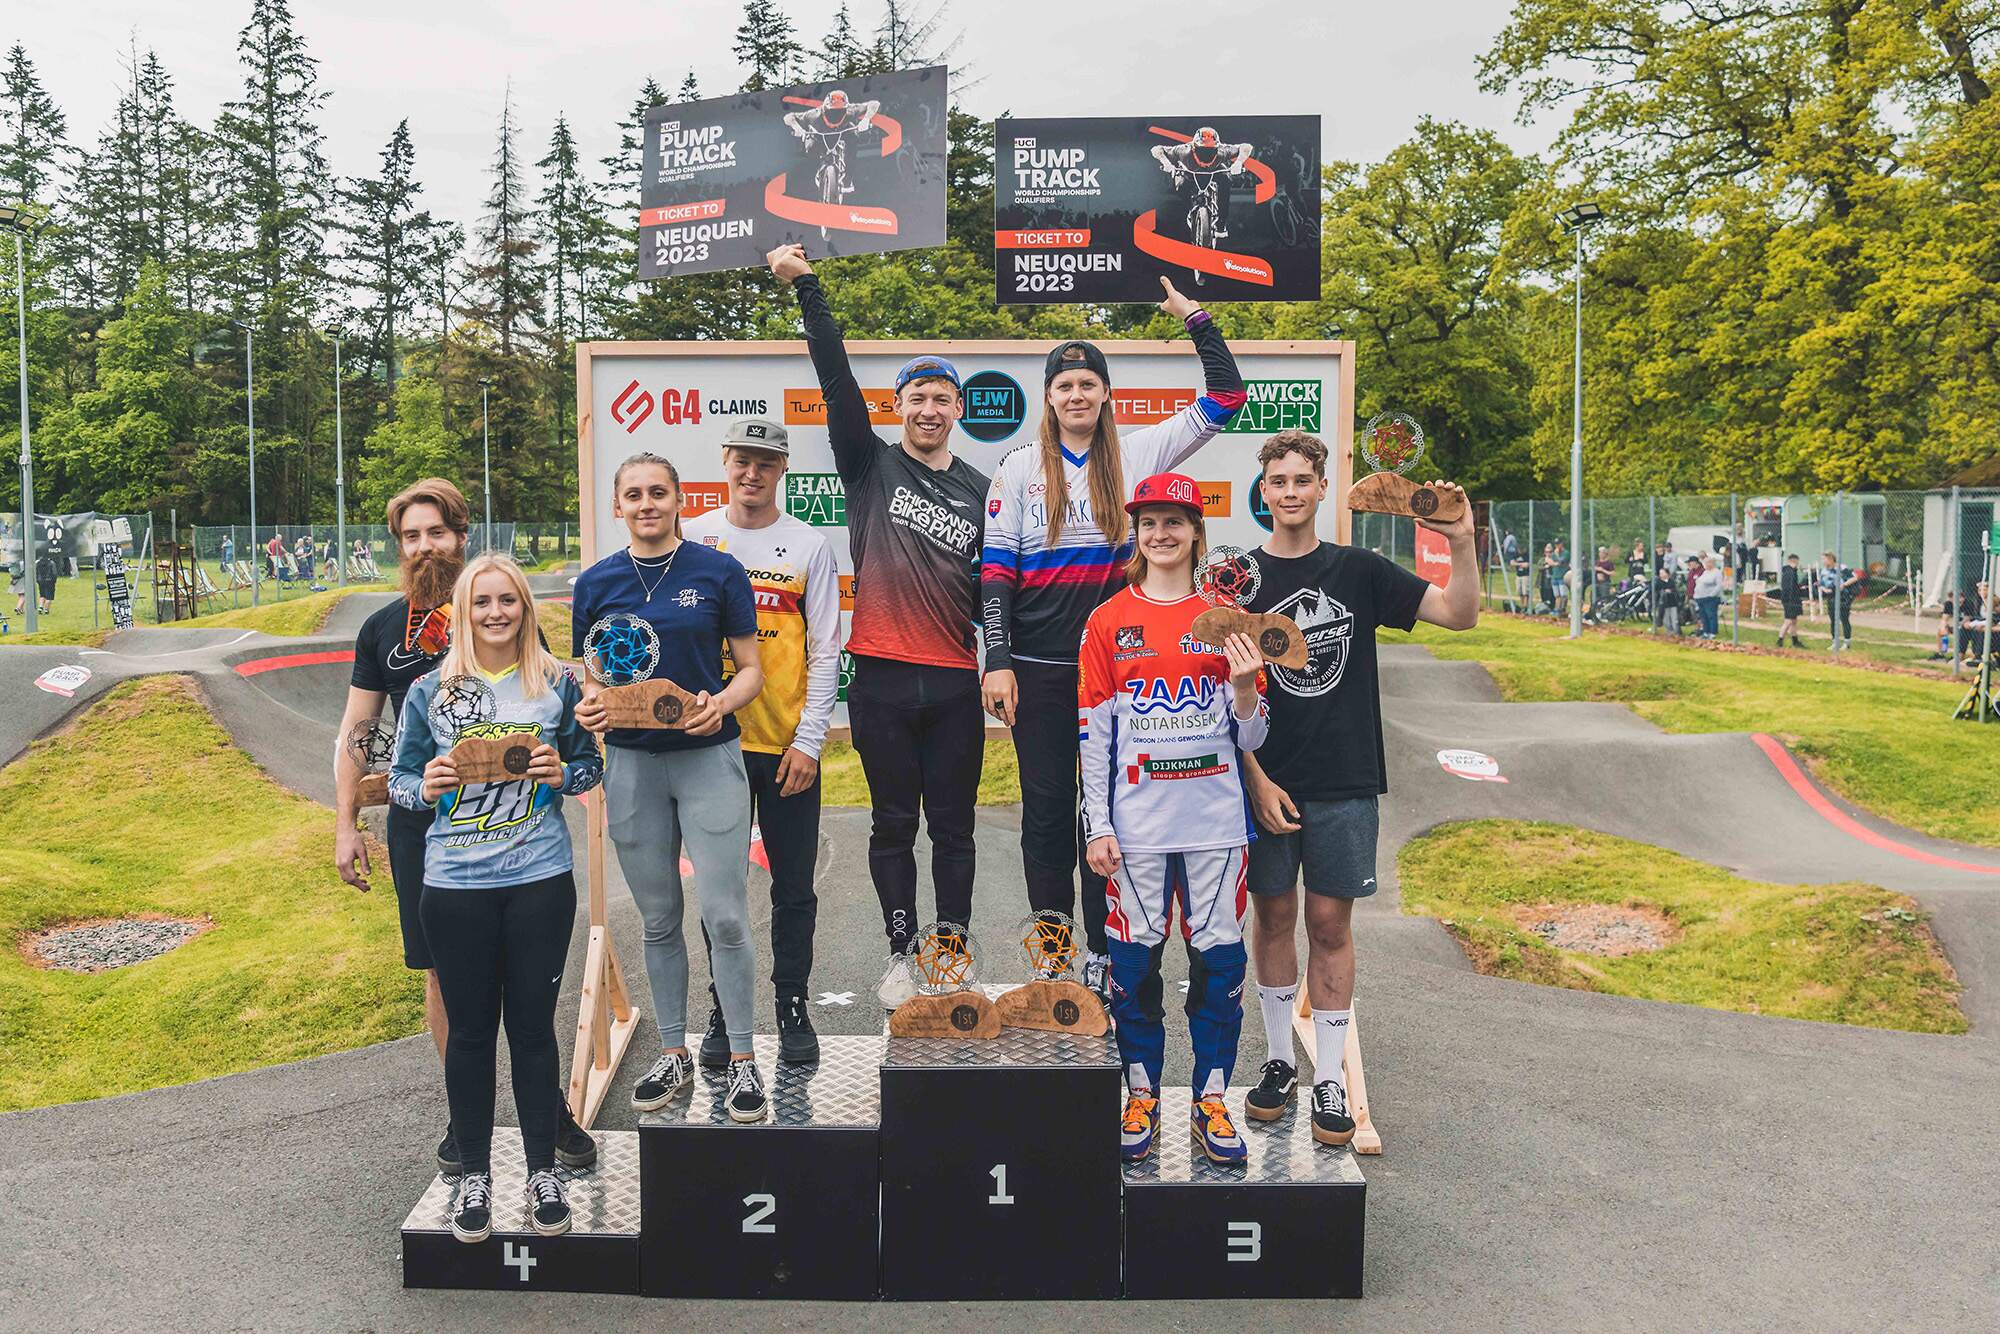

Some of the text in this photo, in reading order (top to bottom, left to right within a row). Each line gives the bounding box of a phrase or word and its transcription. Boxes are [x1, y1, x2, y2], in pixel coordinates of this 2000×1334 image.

[664, 122, 679, 131] UCI
[660, 125, 724, 151] PUMP
[1018, 139, 1035, 147] UCI
[660, 141, 737, 169] TRACK
[1014, 149, 1085, 168] PUMP
[658, 160, 737, 177] WORLD CHAMPIONSHIPS
[658, 172, 695, 183] QUALIFIERS
[1014, 168, 1100, 188] TRACK
[1042, 188, 1101, 196] CHAMPIONSHIPS
[657, 203, 719, 220] TICKET TO
[656, 219, 753, 247] NEUQUEN
[1015, 232, 1083, 244] TICKET TO
[656, 243, 709, 266] 2023
[1014, 254, 1122, 272] NEUQUEN
[1015, 274, 1074, 292] 2023
[972, 391, 1009, 406] EJW
[1246, 383, 1319, 402] AWICK
[662, 389, 767, 425] G4 CLAIMS
[1231, 401, 1318, 431] APER
[788, 477, 796, 494] The
[797, 476, 845, 495] HAW
[1166, 479, 1193, 502] 40
[1416, 494, 1433, 511] 3rd
[894, 486, 978, 539] CHICKSANDS
[928, 518, 973, 552] PARK
[983, 597, 1003, 650] SLOVAKIA
[1263, 633, 1284, 651] 3rd
[1321, 660, 1339, 682] RIDERS
[1127, 677, 1217, 706] ZAAN
[658, 702, 679, 718] 2nd
[1129, 712, 1217, 731] NOTARISSEN
[1178, 734, 1205, 743] GEWOON
[1152, 760, 1201, 771] DIJKMAN
[957, 1010, 973, 1025] 1st
[1059, 1004, 1075, 1020] 1st
[989, 1164, 1015, 1205] 1
[742, 1193, 776, 1233] 2
[1227, 1222, 1262, 1262] 3
[503, 1241, 537, 1282] 4
